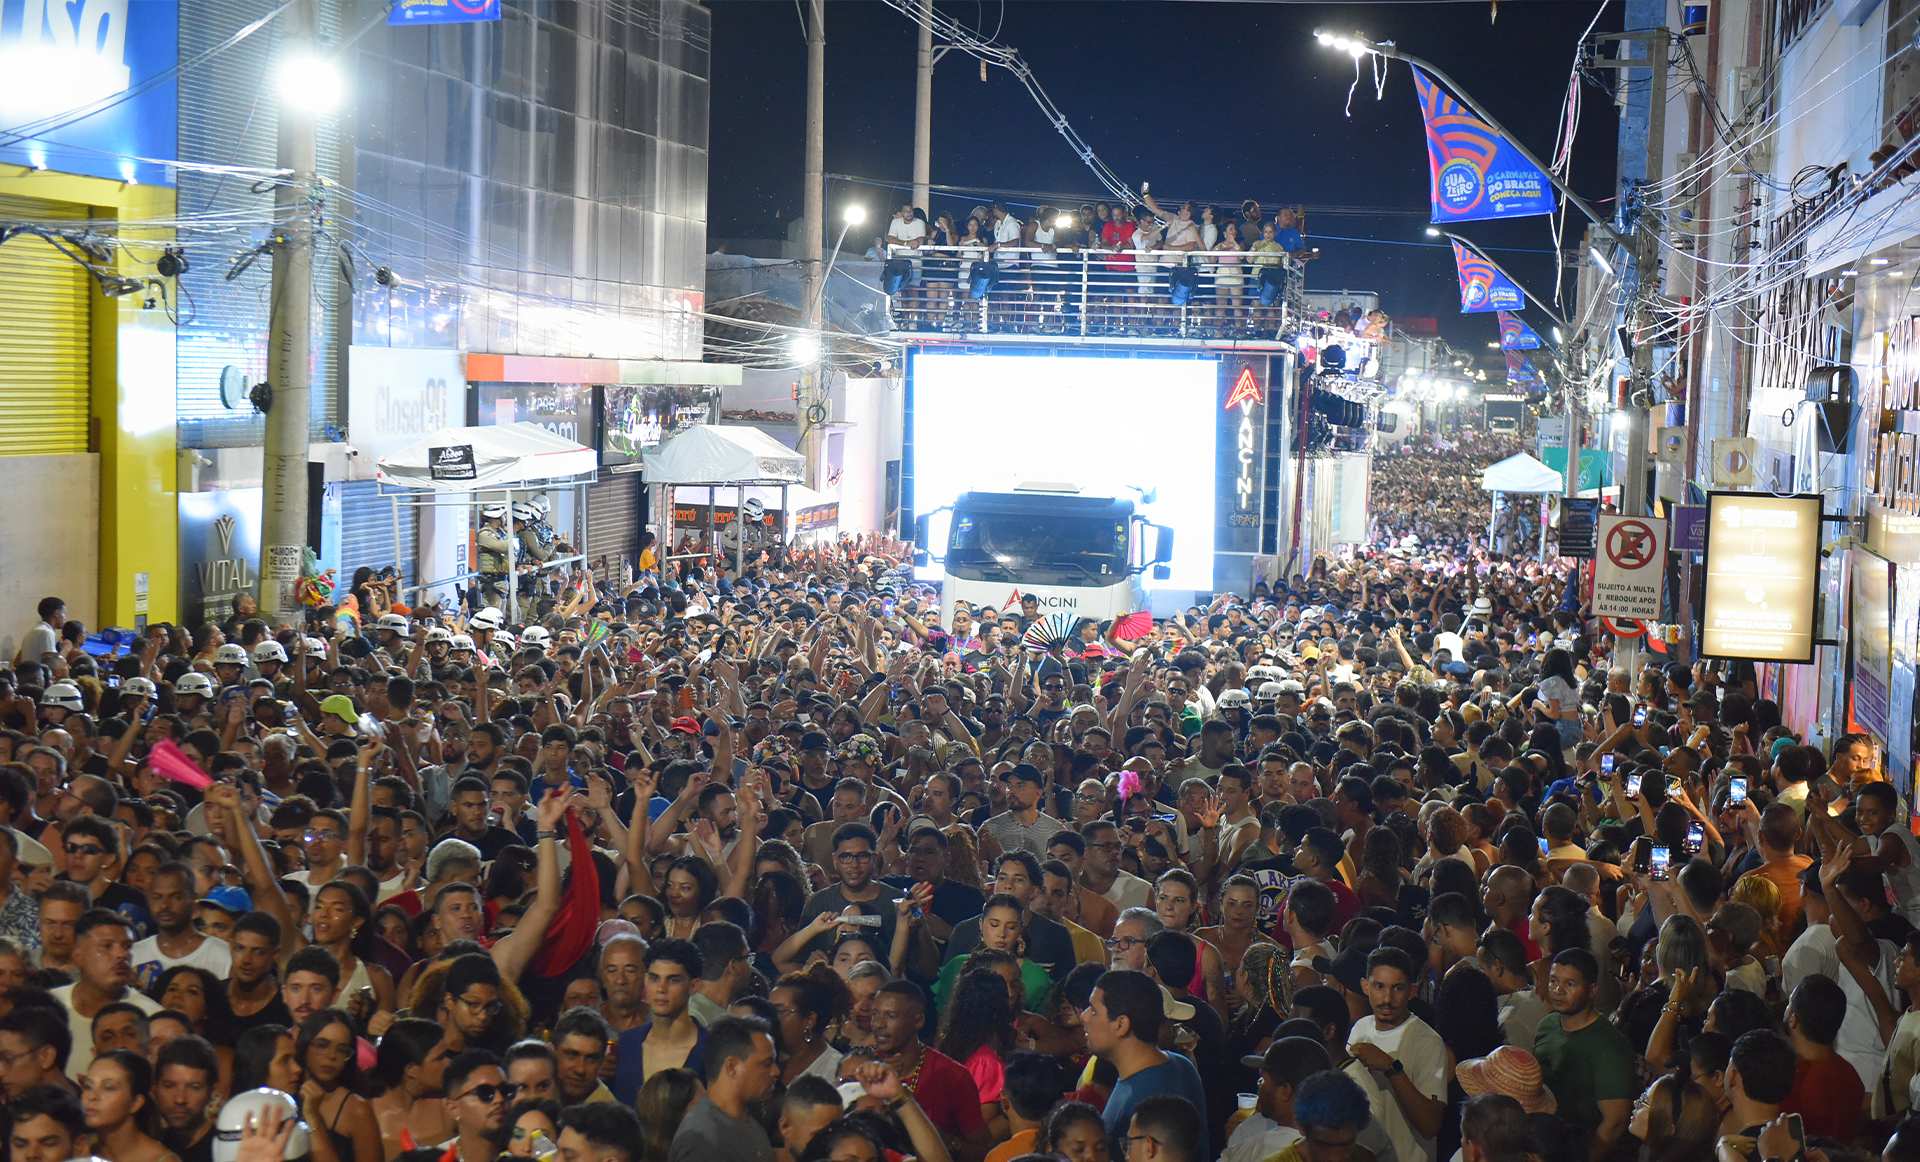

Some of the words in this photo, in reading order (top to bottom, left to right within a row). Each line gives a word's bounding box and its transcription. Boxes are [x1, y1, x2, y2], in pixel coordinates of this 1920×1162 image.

[1486, 175, 1494, 184] O
[1494, 171, 1539, 180] CARNAVAL
[1487, 181, 1503, 196] DO
[1504, 180, 1541, 189] BRASIL
[1490, 190, 1521, 202] COMEÇA
[275, 547, 294, 556] AMOR
[269, 556, 277, 565] DE
[279, 557, 298, 566] VOLTA
[195, 558, 254, 592] VITAL
[1597, 583, 1625, 591] SUJEITO
[1626, 582, 1632, 591] À
[1633, 585, 1655, 594] MULTA
[1605, 594, 1638, 604] REBOQUE
[1638, 597, 1657, 605] APÓS
[1598, 602, 1608, 611] ÀS
[1631, 607, 1655, 615] HORAS
